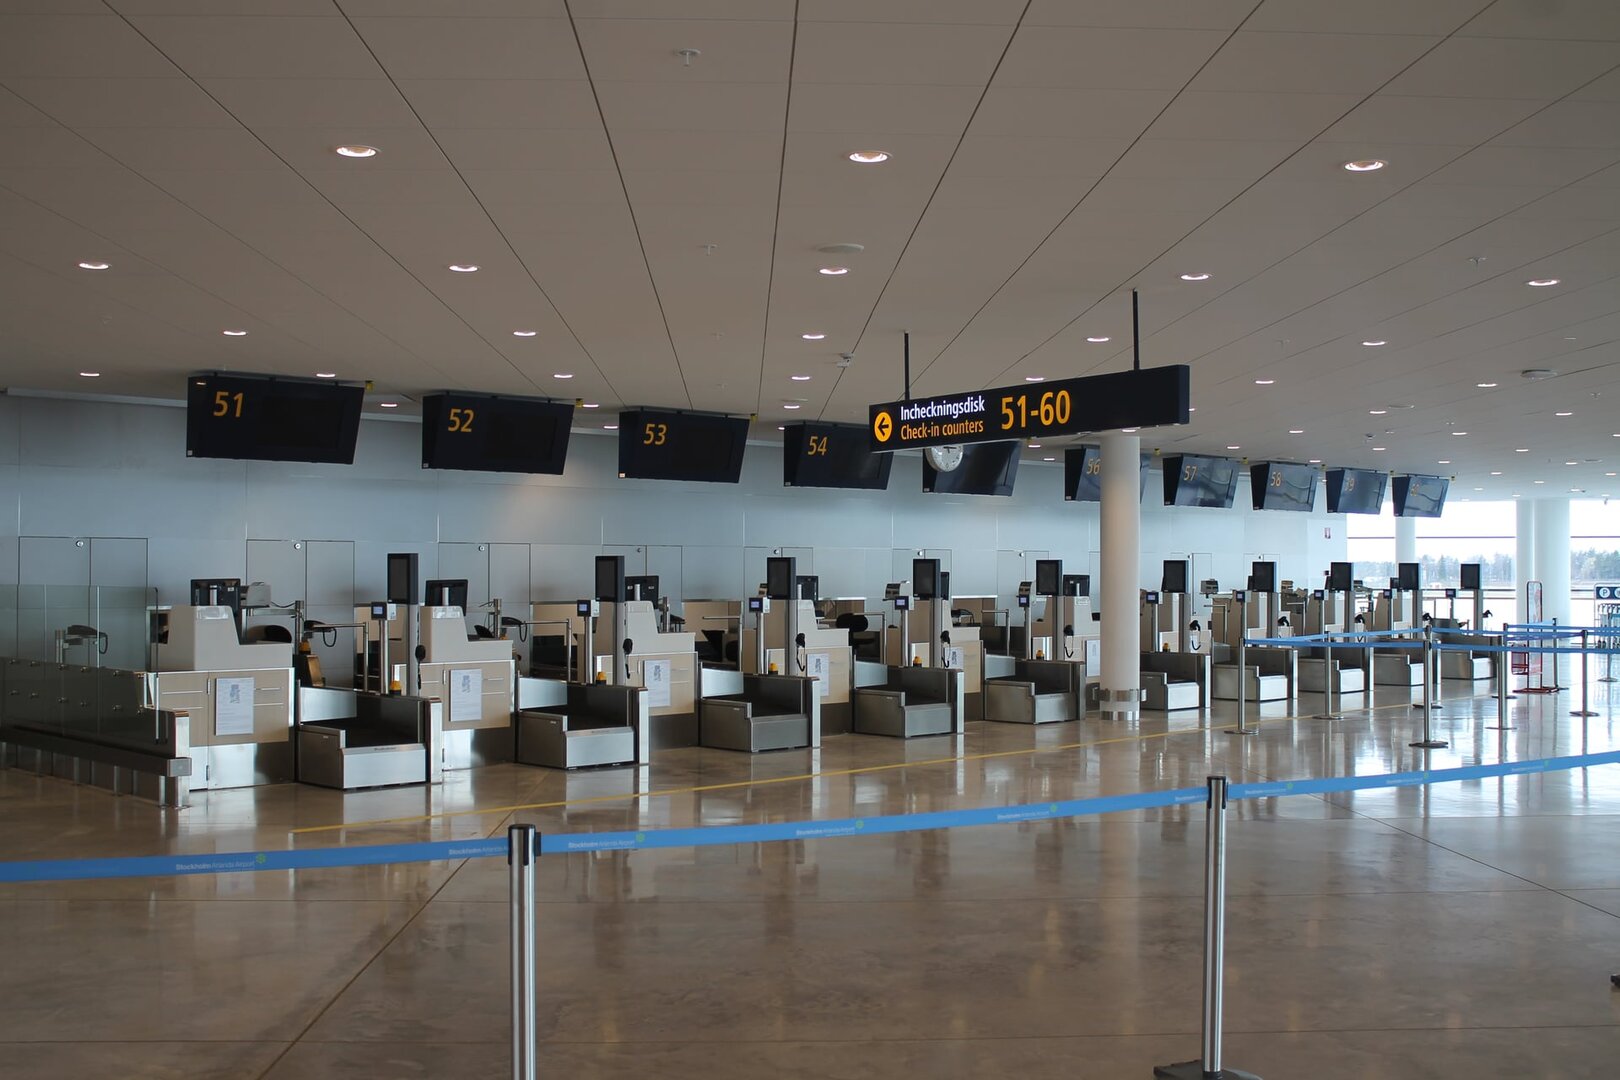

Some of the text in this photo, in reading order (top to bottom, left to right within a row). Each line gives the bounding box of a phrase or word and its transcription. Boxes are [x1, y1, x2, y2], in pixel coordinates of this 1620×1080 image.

[213, 391, 244, 418] 51
[900, 395, 985, 421] Incheckningsdisk
[1001, 390, 1072, 431] 51-60
[448, 408, 475, 433] 52
[900, 419, 984, 441] Check-in counters
[644, 424, 668, 446] 53
[808, 436, 828, 456] 54
[1086, 458, 1101, 475] 56
[1183, 465, 1198, 481] 57
[1270, 472, 1282, 487] 58
[176, 862, 211, 871] Stockholm
[235, 859, 255, 869] Airport
